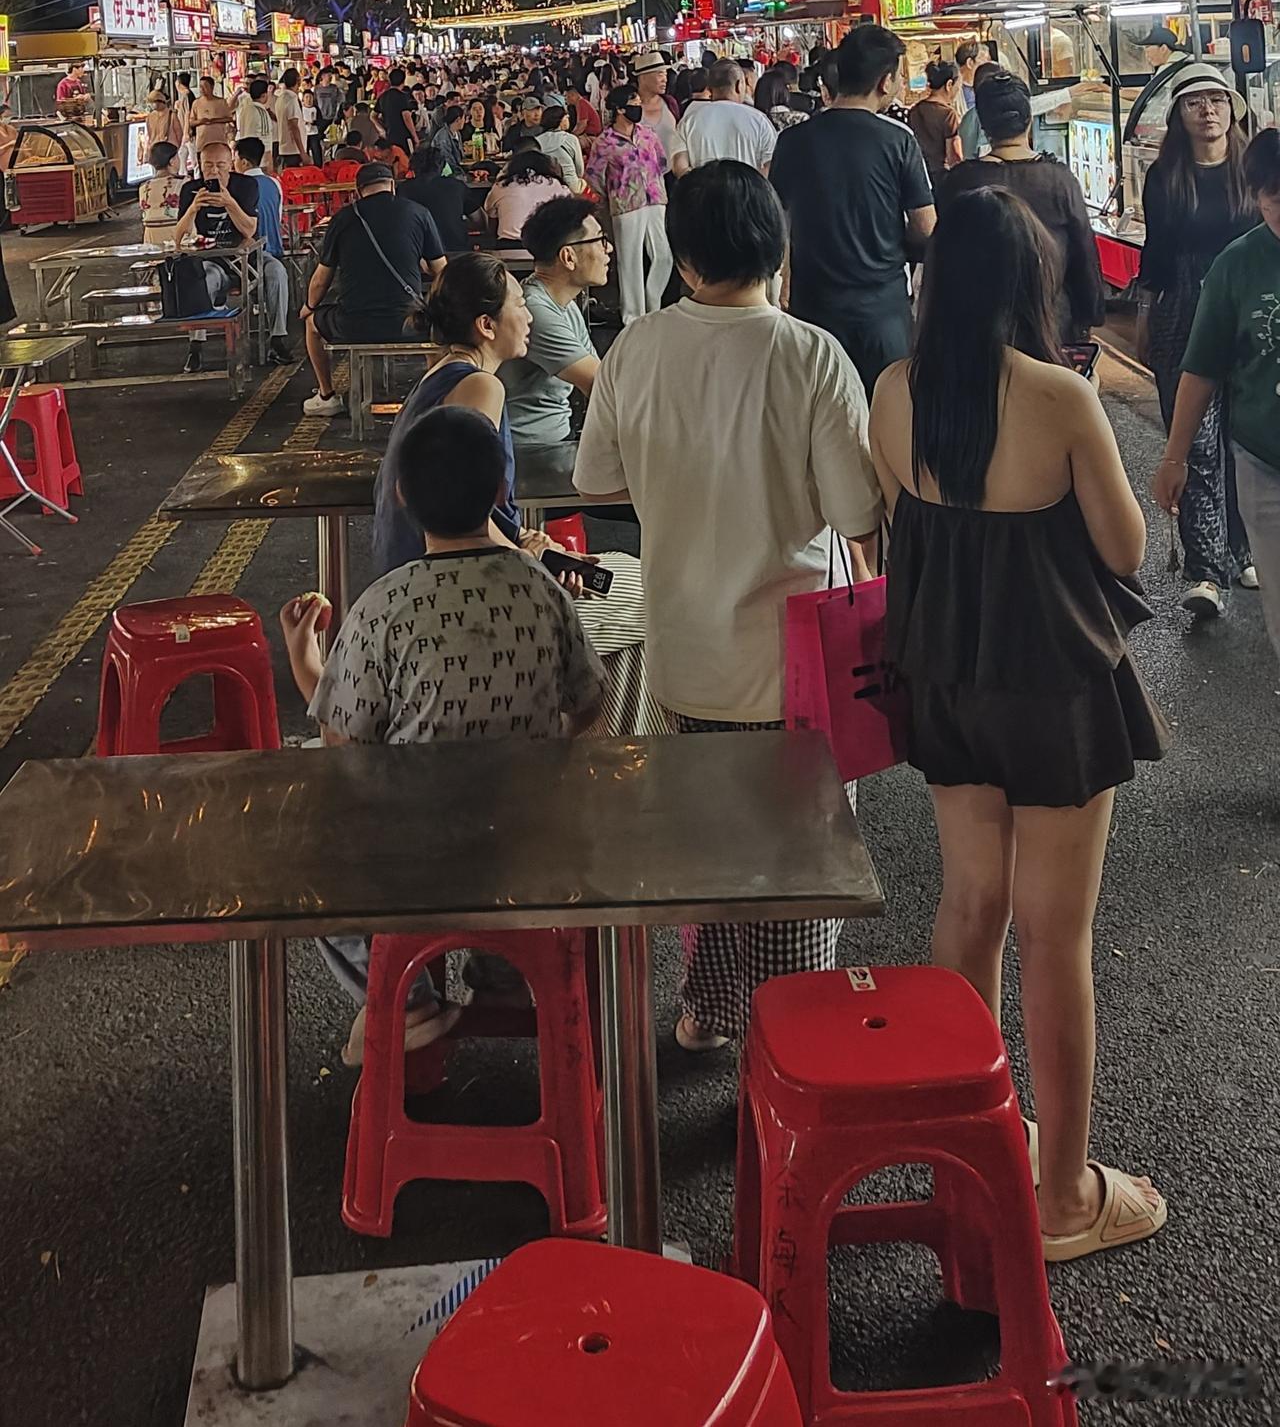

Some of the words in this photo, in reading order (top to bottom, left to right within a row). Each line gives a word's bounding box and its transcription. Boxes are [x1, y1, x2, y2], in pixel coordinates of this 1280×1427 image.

[435, 570, 460, 587] PY
[387, 583, 409, 603] PY
[462, 587, 486, 604] PY
[508, 584, 531, 599] PY
[413, 594, 436, 612] PY
[440, 611, 464, 628] PY
[489, 605, 512, 623] PY
[392, 620, 415, 640] PY
[515, 625, 536, 642] PY
[417, 636, 440, 654] PY
[444, 655, 467, 672] PY
[493, 649, 515, 668] PY
[469, 675, 492, 692] PY
[516, 668, 536, 688] PY
[420, 679, 443, 695] PY
[356, 698, 379, 716] PY
[444, 700, 467, 716] PY
[491, 695, 513, 712] PY
[332, 705, 352, 726] PY
[512, 715, 532, 731] PY
[466, 720, 488, 737] PY
